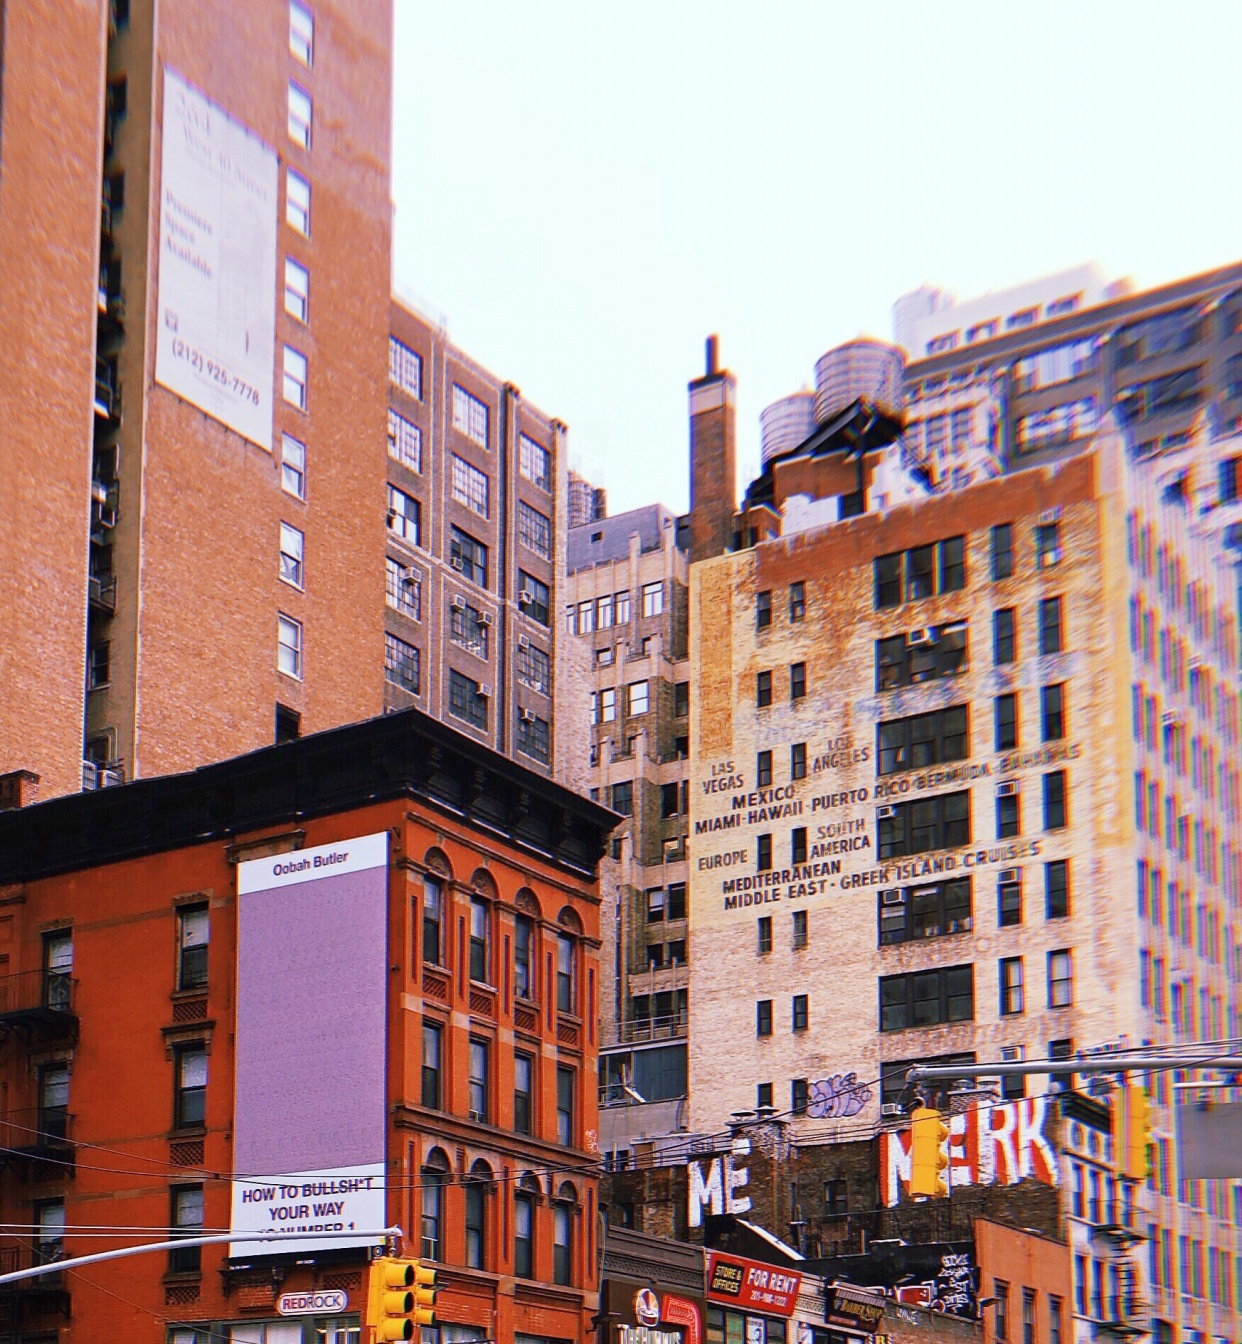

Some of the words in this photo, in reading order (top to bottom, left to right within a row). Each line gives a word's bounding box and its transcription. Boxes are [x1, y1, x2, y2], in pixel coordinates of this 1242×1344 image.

[172, 337, 203, 373] (212)
[207, 359, 260, 406] 925-7778
[828, 737, 854, 751] LOS
[711, 761, 736, 776] LAS
[812, 747, 870, 773] ANGELES
[703, 774, 744, 795] VEGAS
[732, 785, 796, 810] MEXICO
[812, 787, 869, 811] PUERTO
[817, 818, 866, 839] SOUTH
[809, 835, 871, 859] AMERICA
[273, 858, 310, 876] Oobah
[314, 852, 349, 868] Butler
[698, 850, 748, 871] EUROPE
[722, 860, 841, 893] MEDITERRANEAN
[724, 888, 780, 910] MIDDLE
[788, 880, 827, 899] EAST
[840, 868, 890, 890] GREEK
[896, 857, 956, 880] ISLAND
[963, 840, 1041, 867] CRUISES
[242, 1187, 276, 1203] HOW
[279, 1186, 298, 1199] TO
[269, 1205, 309, 1221] YOUR
[313, 1202, 345, 1216] WAY
[715, 1265, 737, 1279] STORE
[747, 1267, 769, 1288] FOR
[769, 1273, 797, 1294] RENT
[712, 1278, 740, 1293] OFFICES
[282, 1295, 342, 1310] REDROCK
